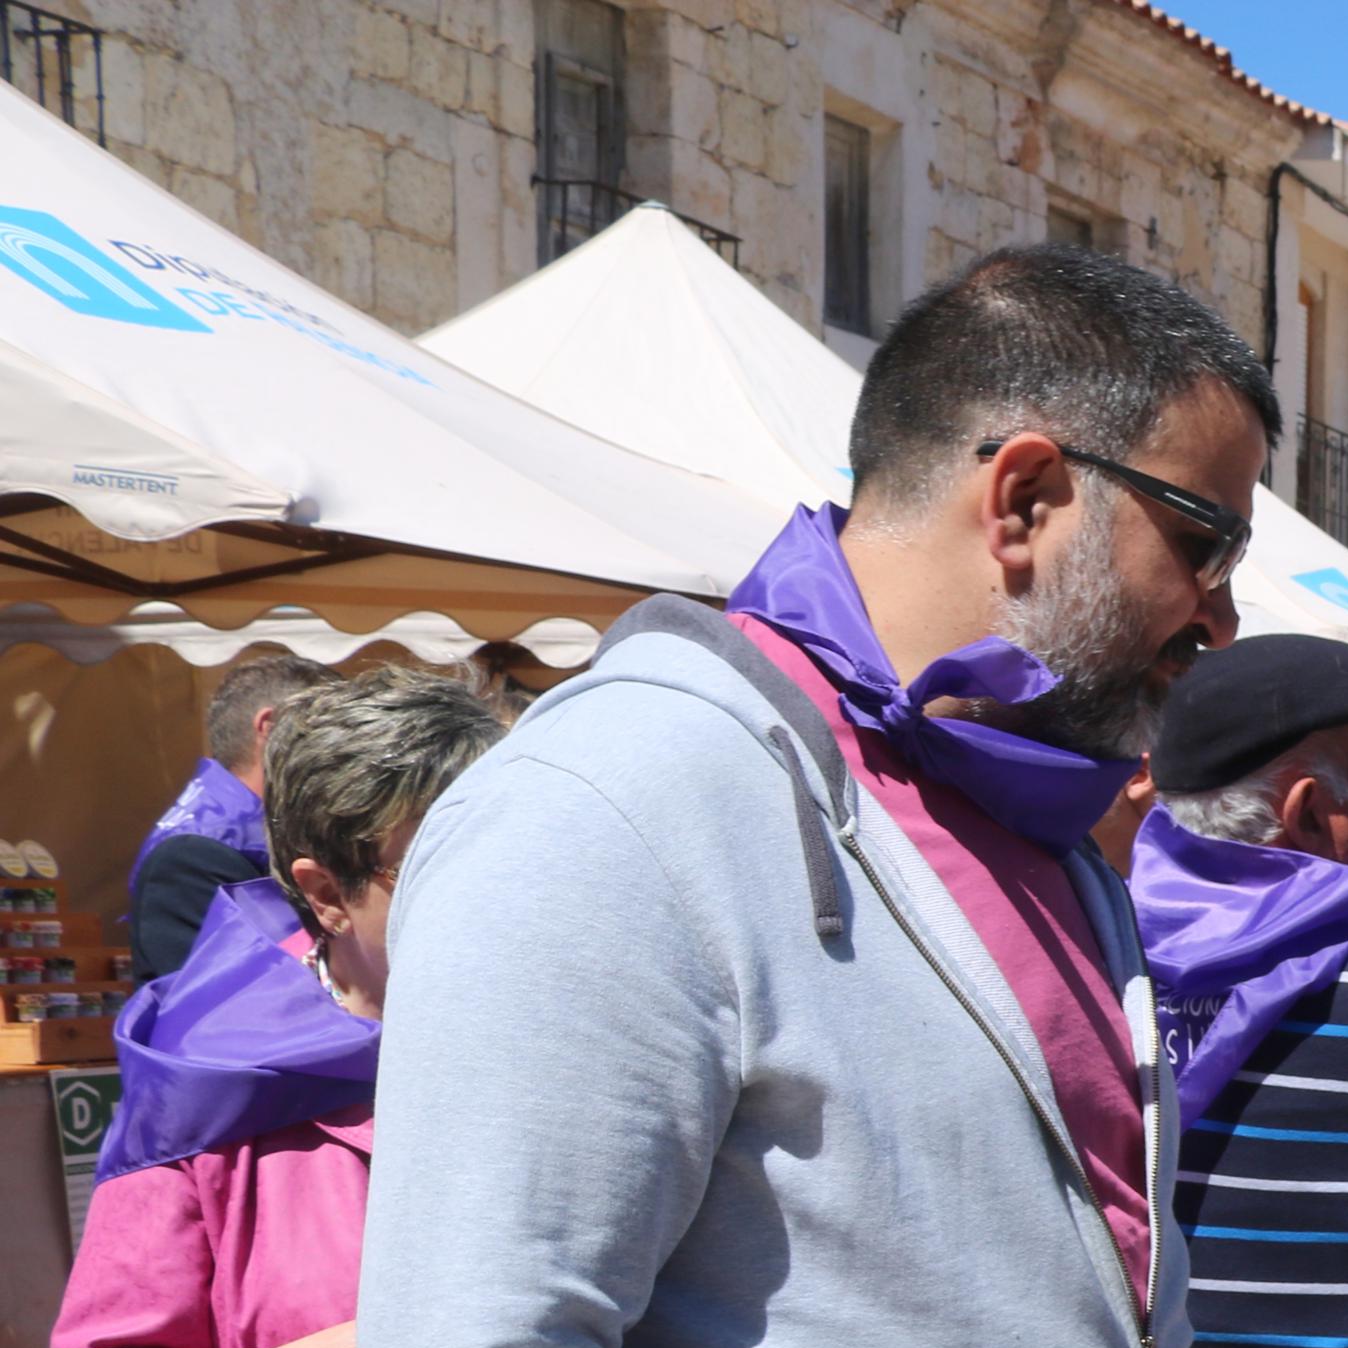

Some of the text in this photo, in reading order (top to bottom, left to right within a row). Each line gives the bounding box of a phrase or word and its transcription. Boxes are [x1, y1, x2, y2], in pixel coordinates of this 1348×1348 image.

[174, 286, 267, 321] DE
[72, 472, 179, 496] MASTERTENT
[71, 1096, 92, 1131] D
